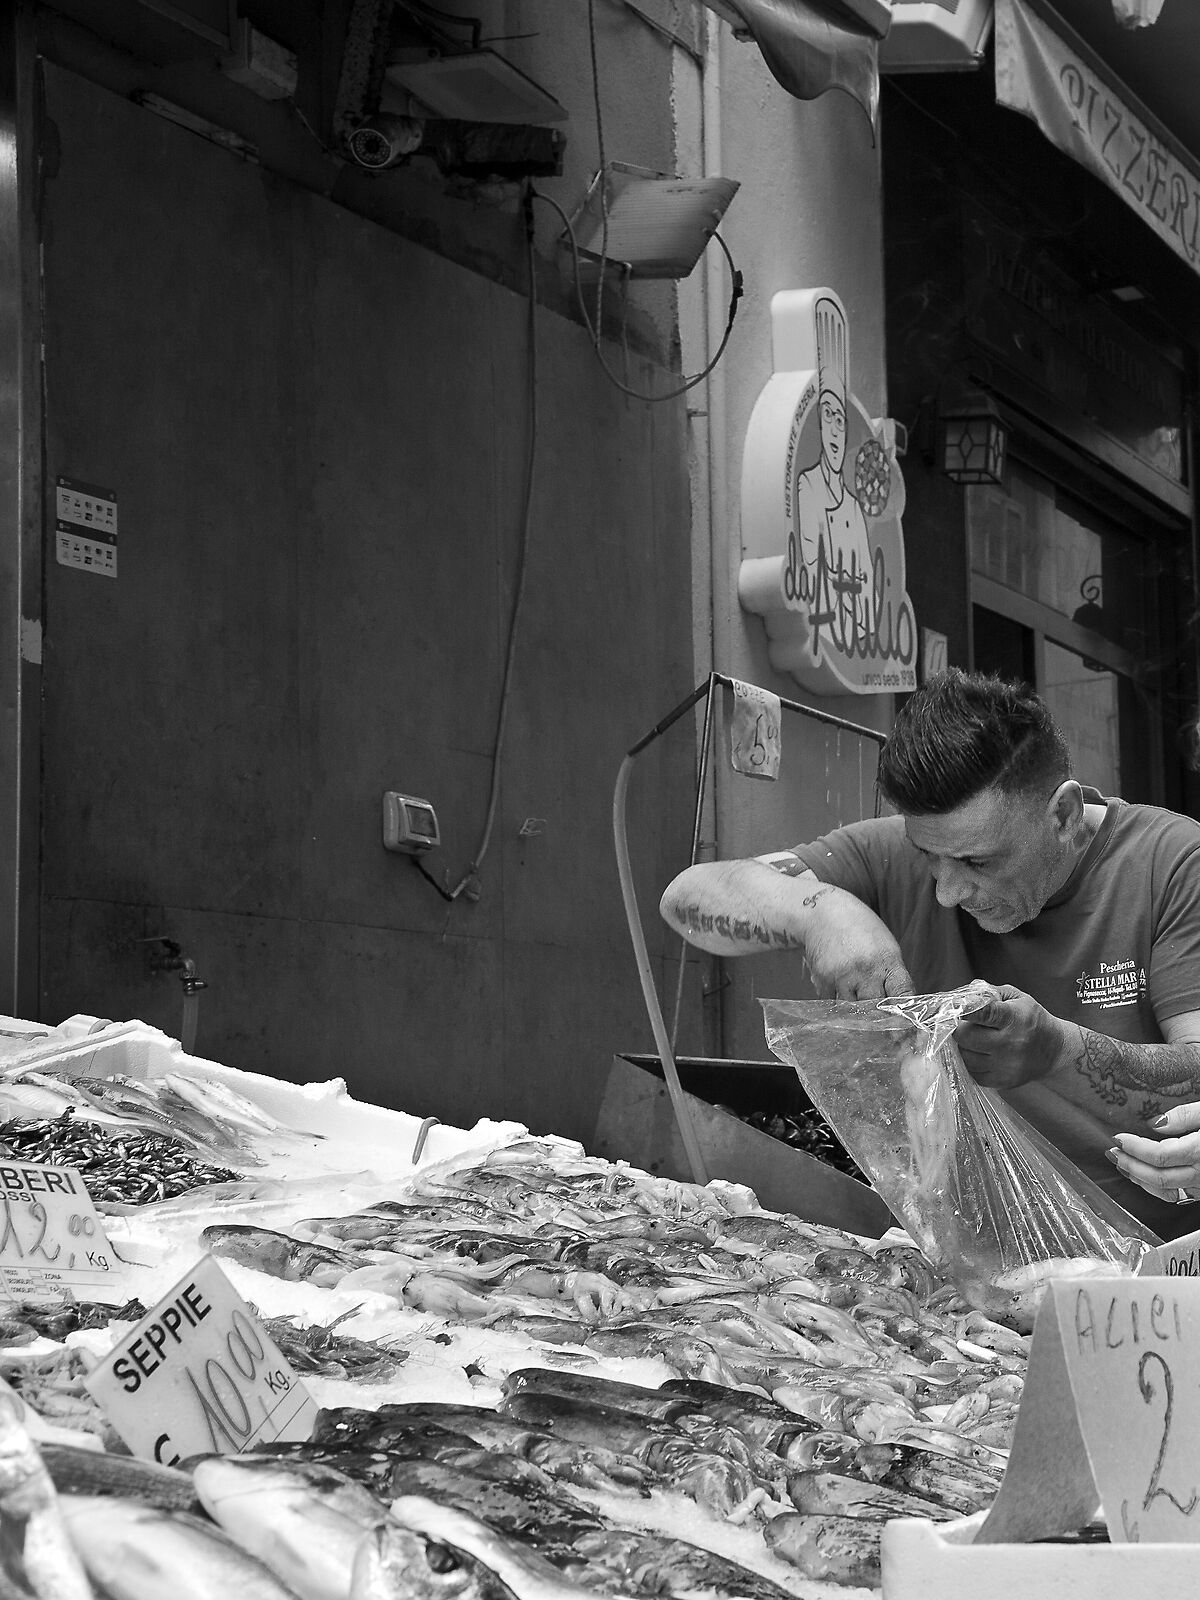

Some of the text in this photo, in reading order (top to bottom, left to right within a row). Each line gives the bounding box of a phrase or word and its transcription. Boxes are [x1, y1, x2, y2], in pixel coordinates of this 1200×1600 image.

[785, 426, 797, 519] RISTORANTE
[785, 531, 914, 666] da Attilio
[1084, 976, 1116, 990] STELLA
[1100, 958, 1135, 974] Pescheria
[0, 1167, 77, 1195] BERI
[113, 1283, 212, 1393] SEPPIE
